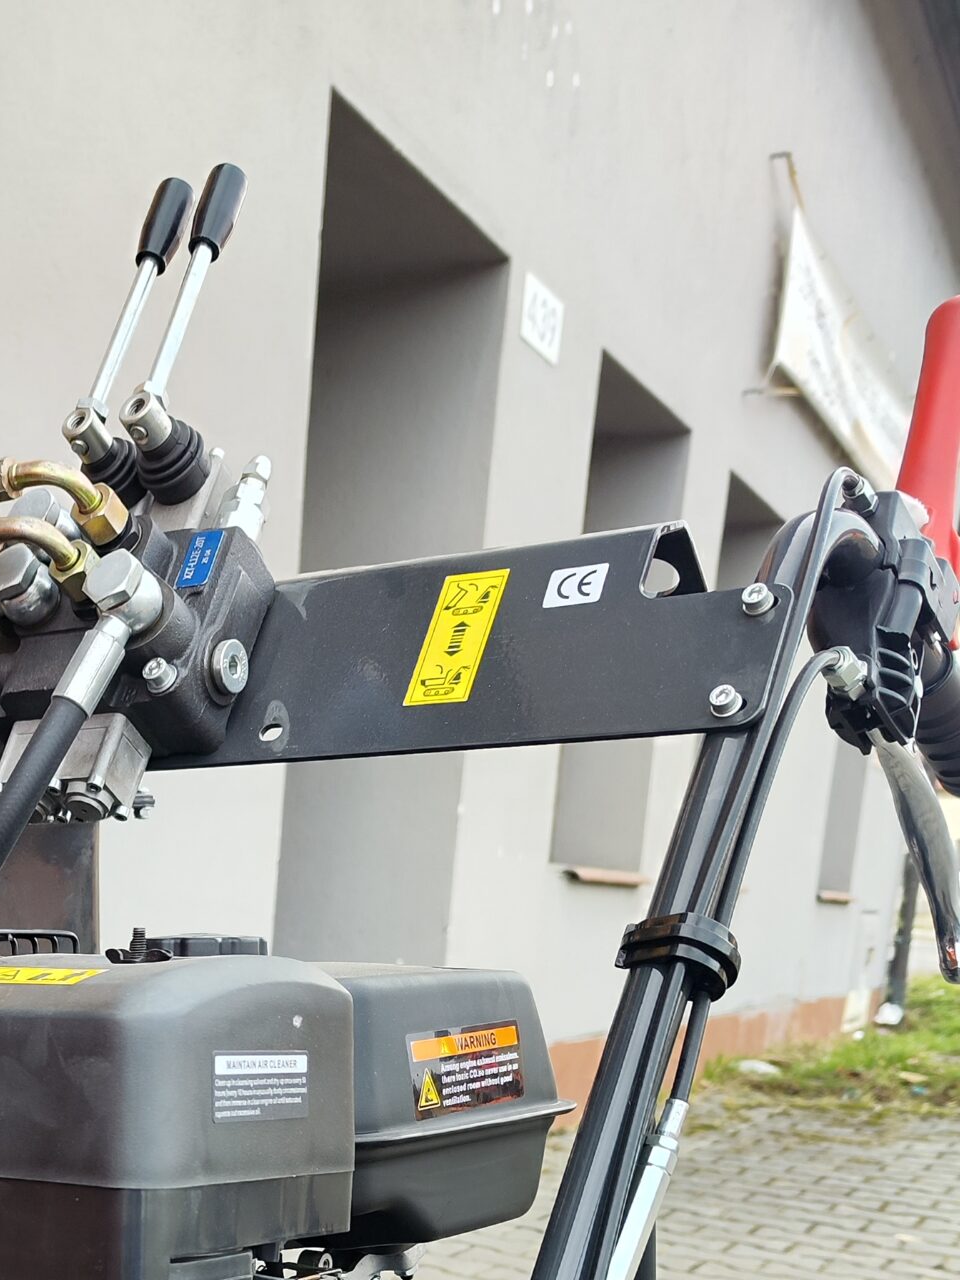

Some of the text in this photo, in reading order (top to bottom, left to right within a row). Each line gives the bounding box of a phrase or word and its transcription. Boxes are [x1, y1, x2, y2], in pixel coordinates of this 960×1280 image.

[557, 570, 597, 599] CE
[454, 1032, 497, 1051] WARNING
[226, 1059, 297, 1070] MAINTAIN AIR CLEANER
